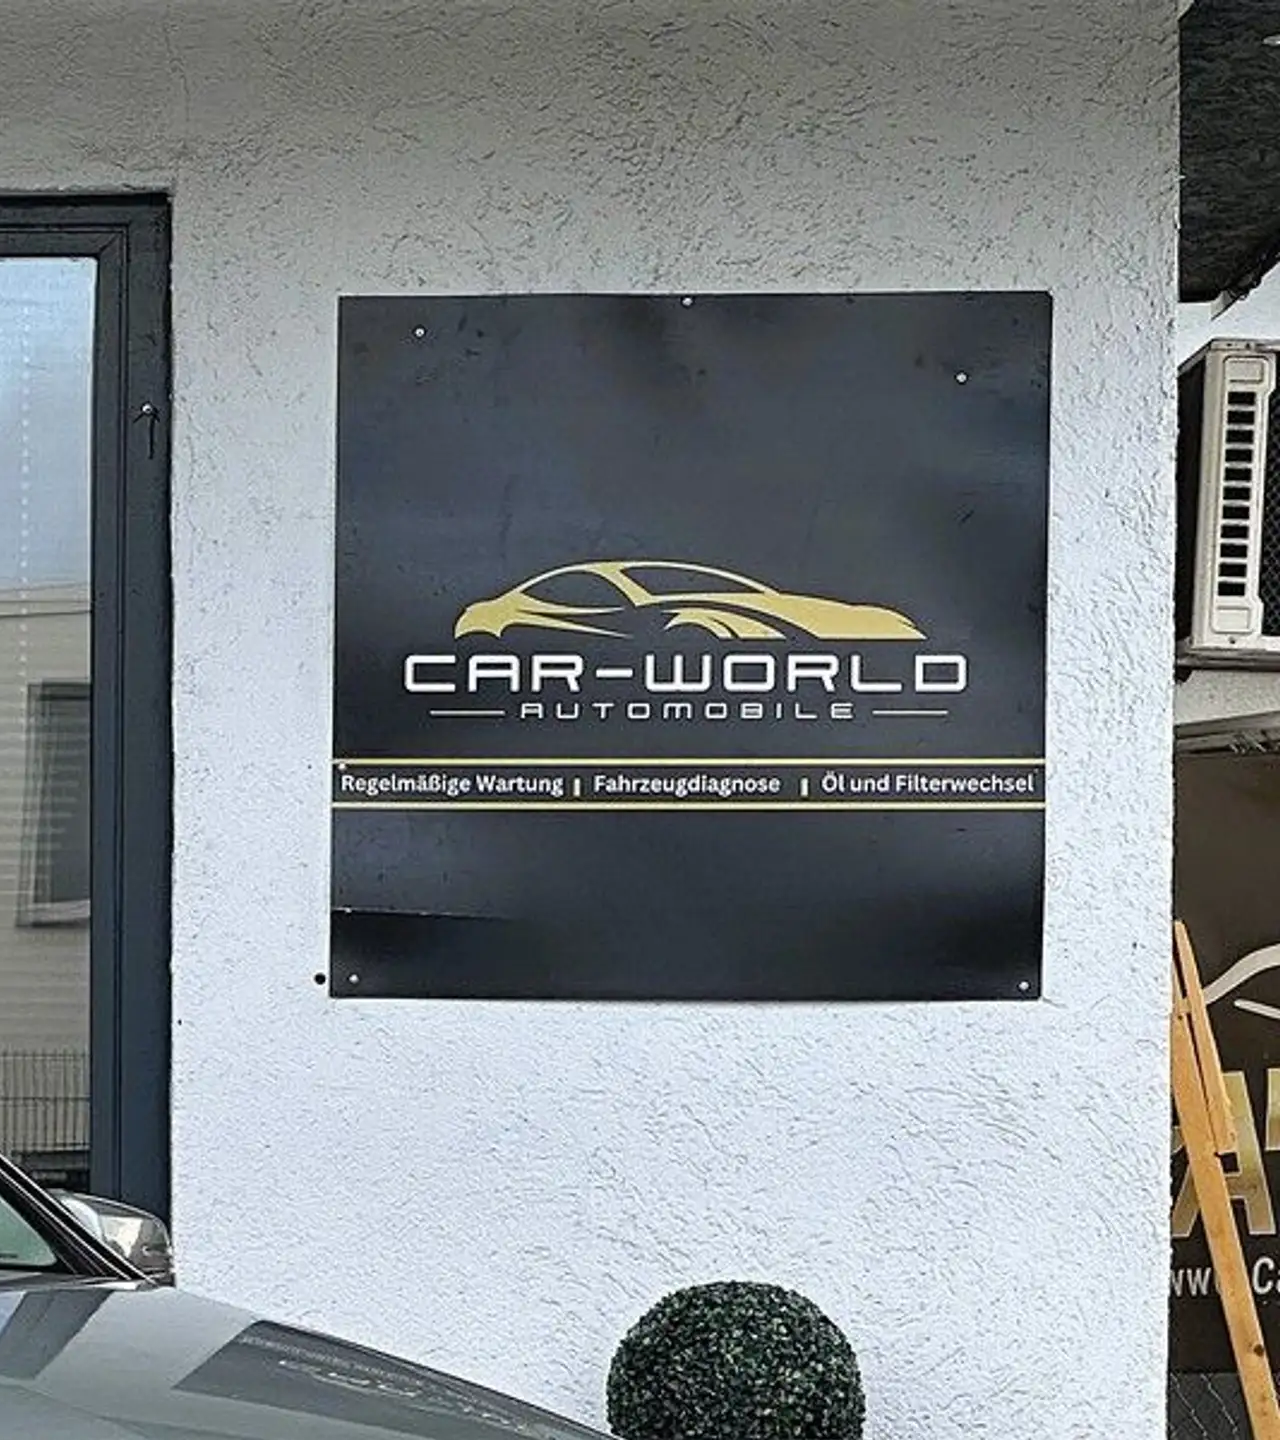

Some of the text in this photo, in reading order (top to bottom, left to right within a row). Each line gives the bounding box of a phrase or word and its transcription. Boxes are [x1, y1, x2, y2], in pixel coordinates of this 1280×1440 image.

[403, 654, 968, 693] CAR-WORLD
[520, 702, 854, 720] AUTOMOBILE
[341, 770, 1035, 797] Regelmäßige Wartung Fahrzeugdiagnose Öl und Filterwechsel
